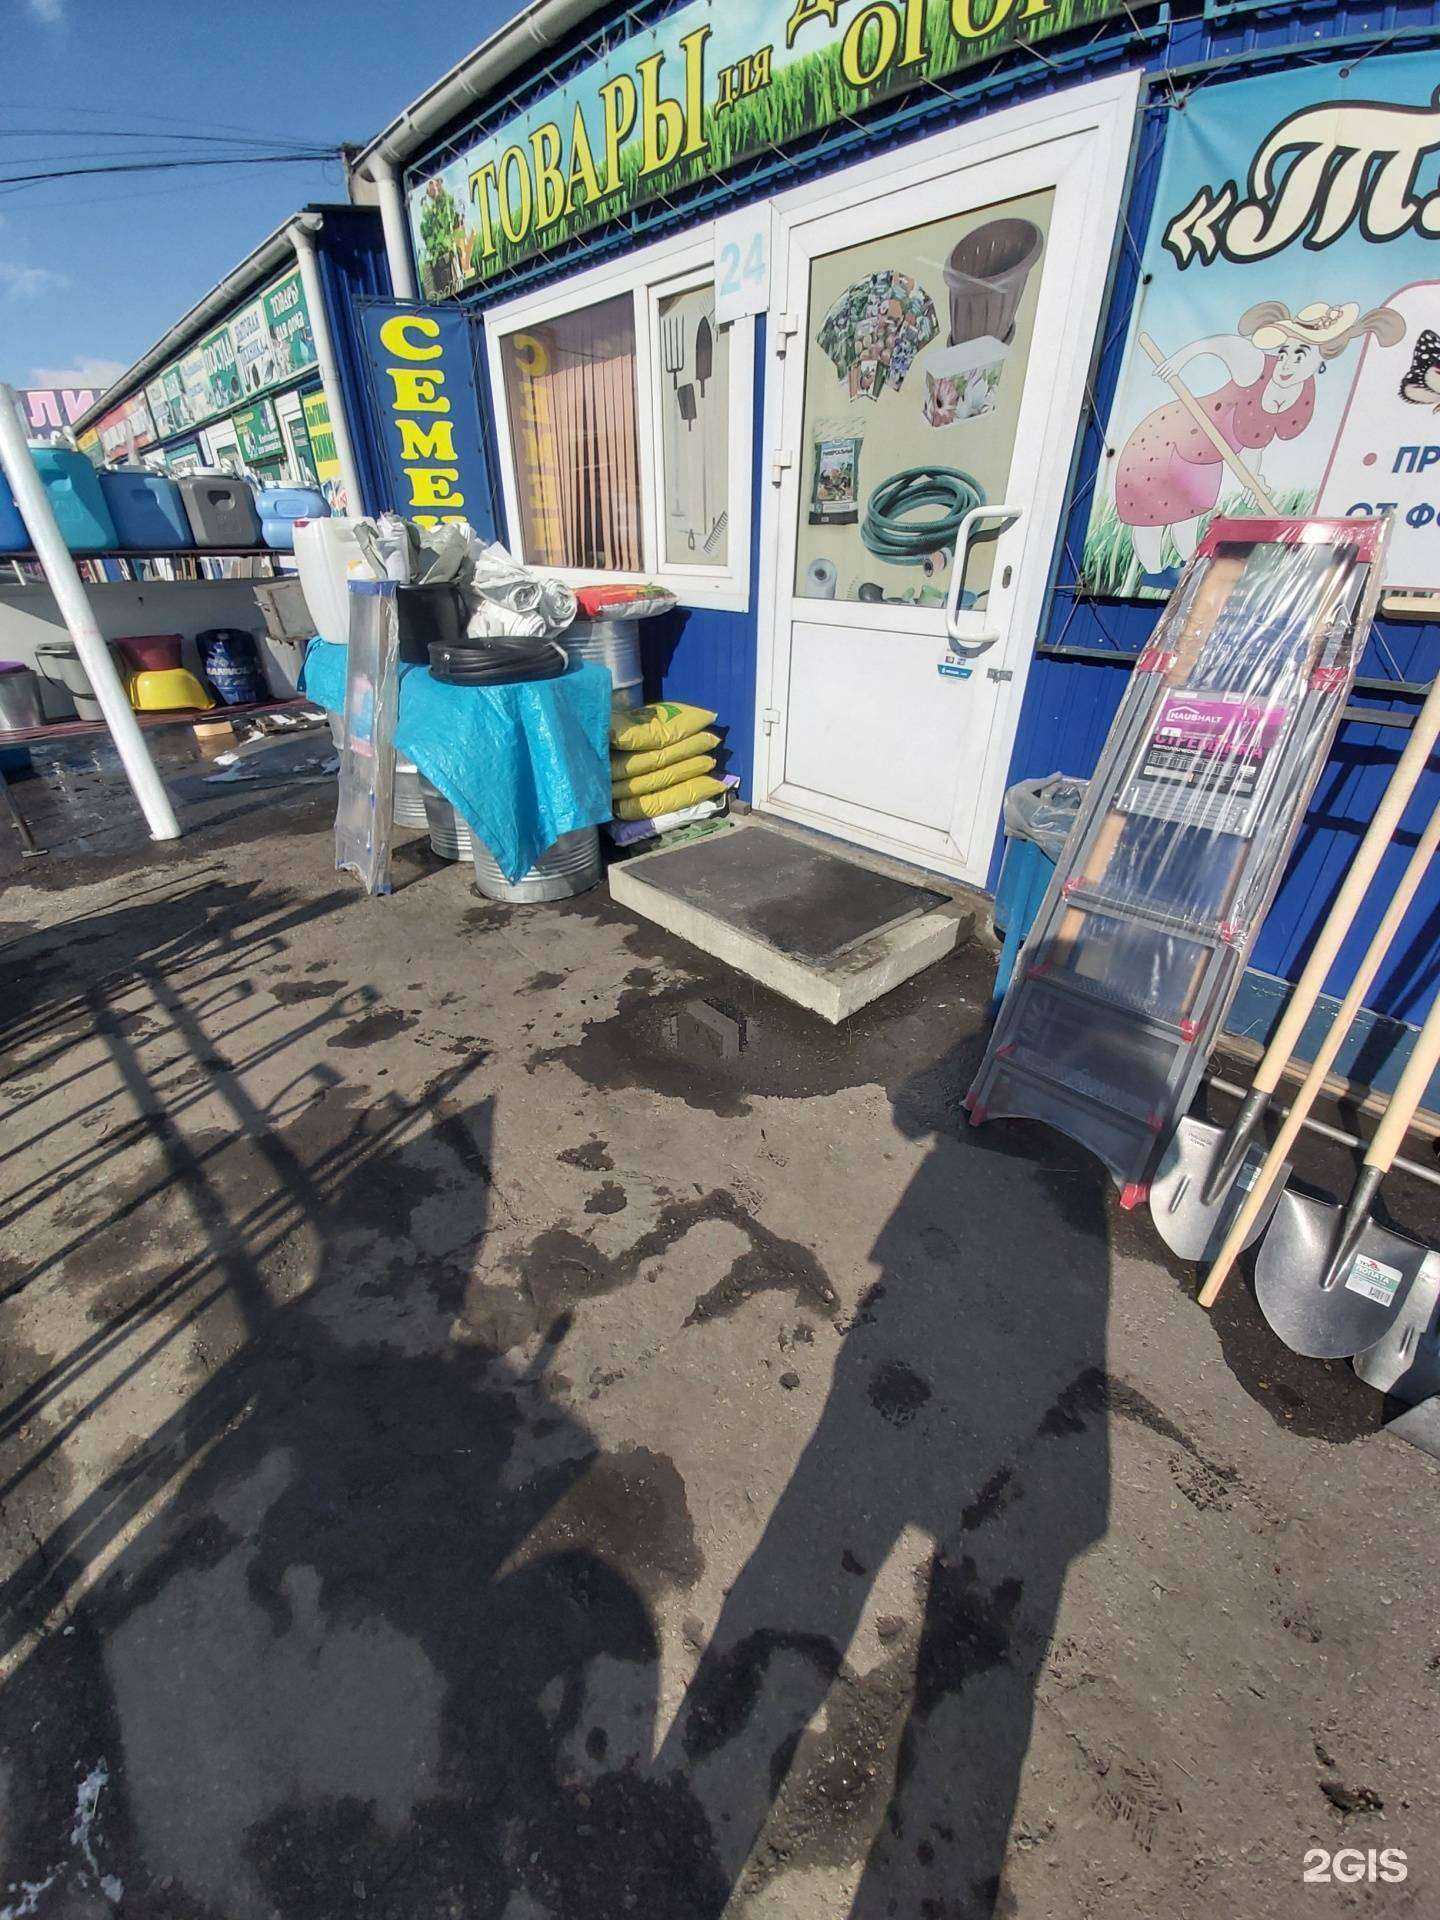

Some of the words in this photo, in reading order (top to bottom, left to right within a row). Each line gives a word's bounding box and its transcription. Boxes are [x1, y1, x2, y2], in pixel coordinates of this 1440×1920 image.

[467, 24, 713, 260] ТОВАРЫ
[714, 46, 774, 120] для
[720, 231, 766, 297] 24
[27, 390, 108, 428] ЛИ
[1406, 502, 1440, 529] Ф
[1170, 710, 1224, 724] HAUSHALT
